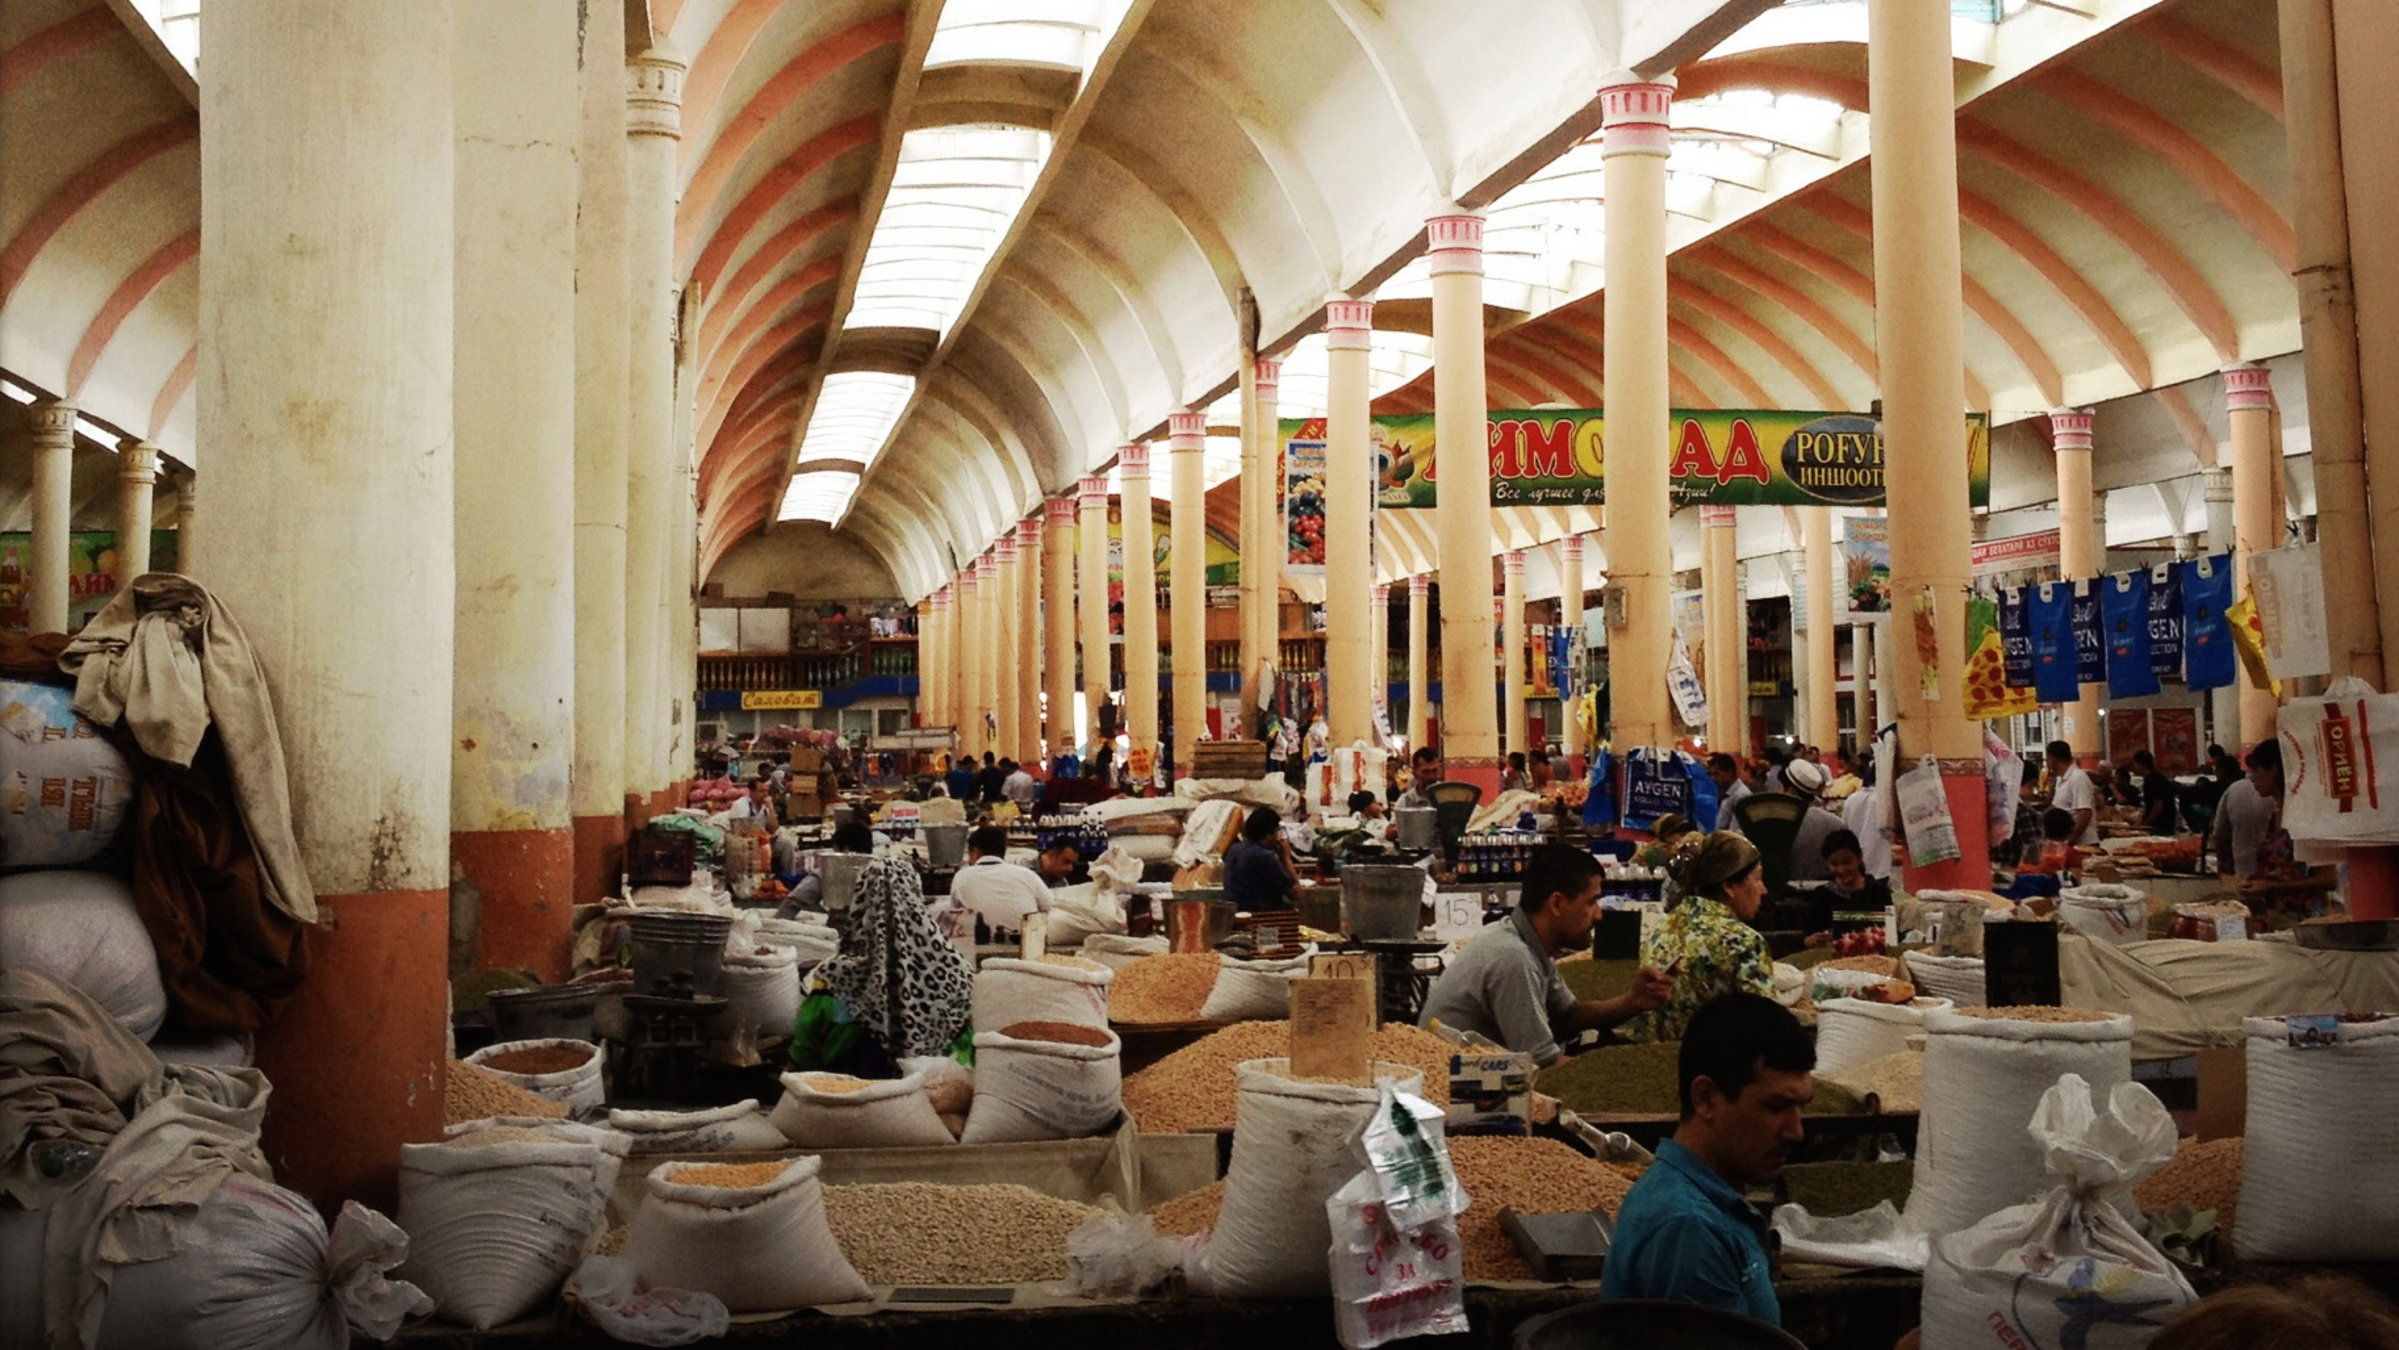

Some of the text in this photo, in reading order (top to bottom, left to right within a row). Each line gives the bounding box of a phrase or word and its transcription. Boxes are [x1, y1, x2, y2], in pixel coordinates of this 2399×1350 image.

[1422, 418, 1771, 486] ИМОАД
[1799, 466, 1886, 488] ИНШООТ
[1495, 482, 1521, 500] Все
[1528, 486, 1575, 502] лучшее
[2330, 725, 2352, 791] ОРИЁН
[1634, 781, 1681, 797] AYGEN
[1446, 898, 1470, 926] 15
[1323, 959, 1355, 978] 10
[1480, 1060, 1510, 1071] CARS
